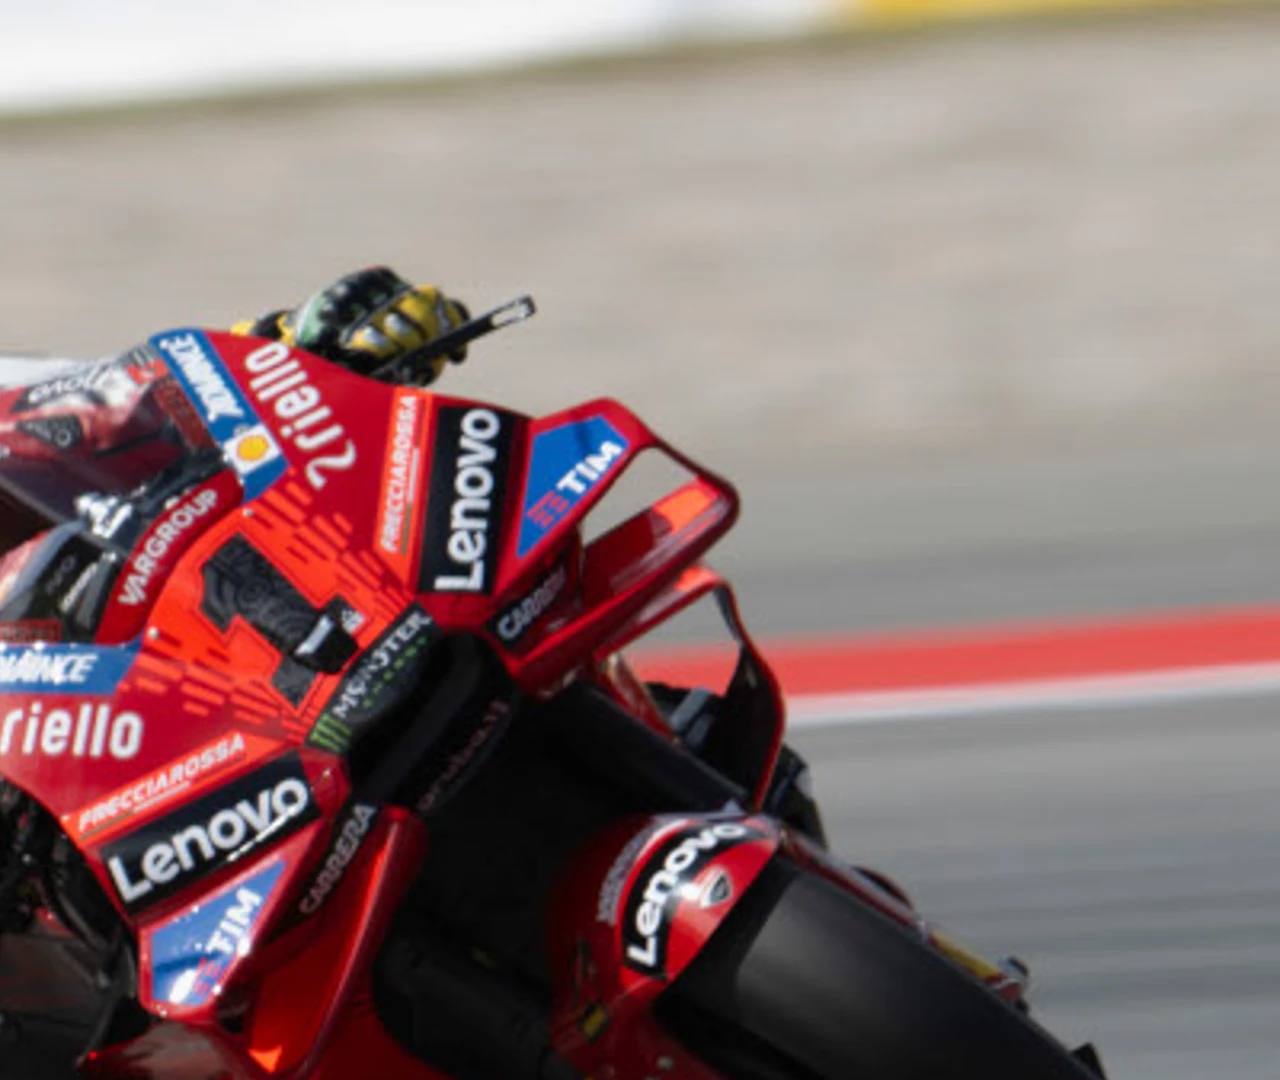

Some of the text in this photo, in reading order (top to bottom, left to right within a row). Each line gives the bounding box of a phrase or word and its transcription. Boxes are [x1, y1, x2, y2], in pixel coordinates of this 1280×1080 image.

[379, 395, 418, 554] FRECCIAROSSA
[434, 408, 500, 593] Lenovo
[557, 439, 622, 495] TIM
[78, 733, 246, 834] FRECCIAROSSA
[108, 777, 310, 902] Lenovo
[206, 888, 264, 958] TIM
[628, 821, 747, 966] Lenovo
